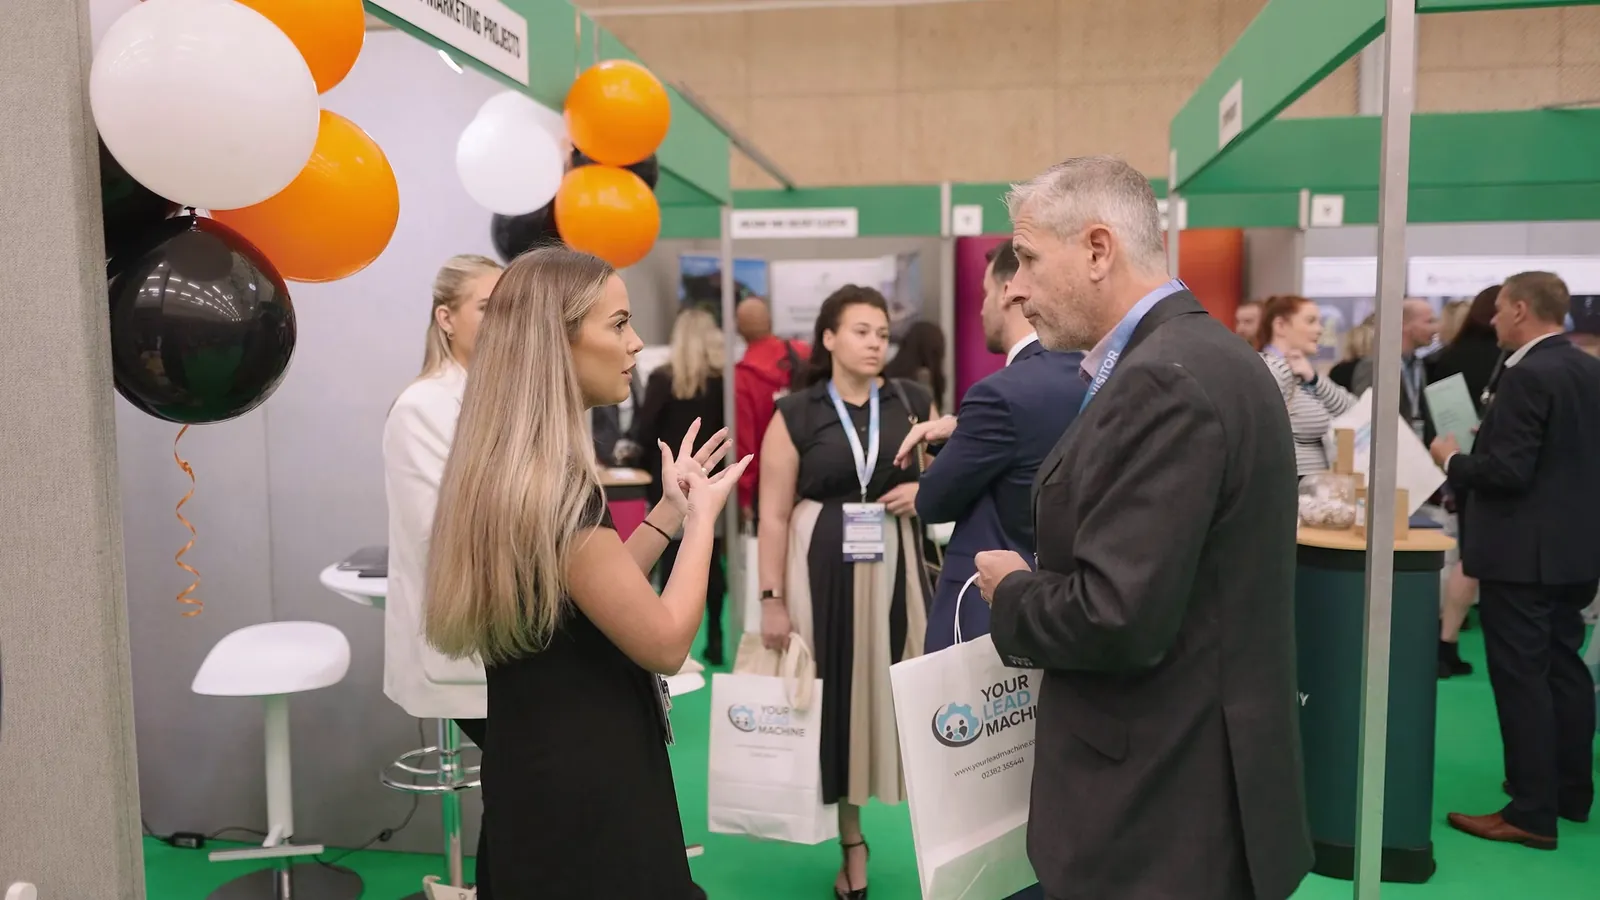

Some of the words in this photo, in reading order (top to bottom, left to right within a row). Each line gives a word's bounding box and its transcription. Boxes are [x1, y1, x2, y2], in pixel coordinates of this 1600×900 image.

[426, 0, 481, 35] RKETING
[483, 15, 520, 59] PROJECTS
[1089, 350, 1120, 396] VISITOR
[980, 674, 1029, 702] YOUR
[761, 705, 790, 716] YOUR
[983, 690, 1031, 720] LEAD
[758, 726, 806, 738] MACHINE
[981, 766, 1002, 780] 02382
[1002, 757, 1025, 771] 355441
